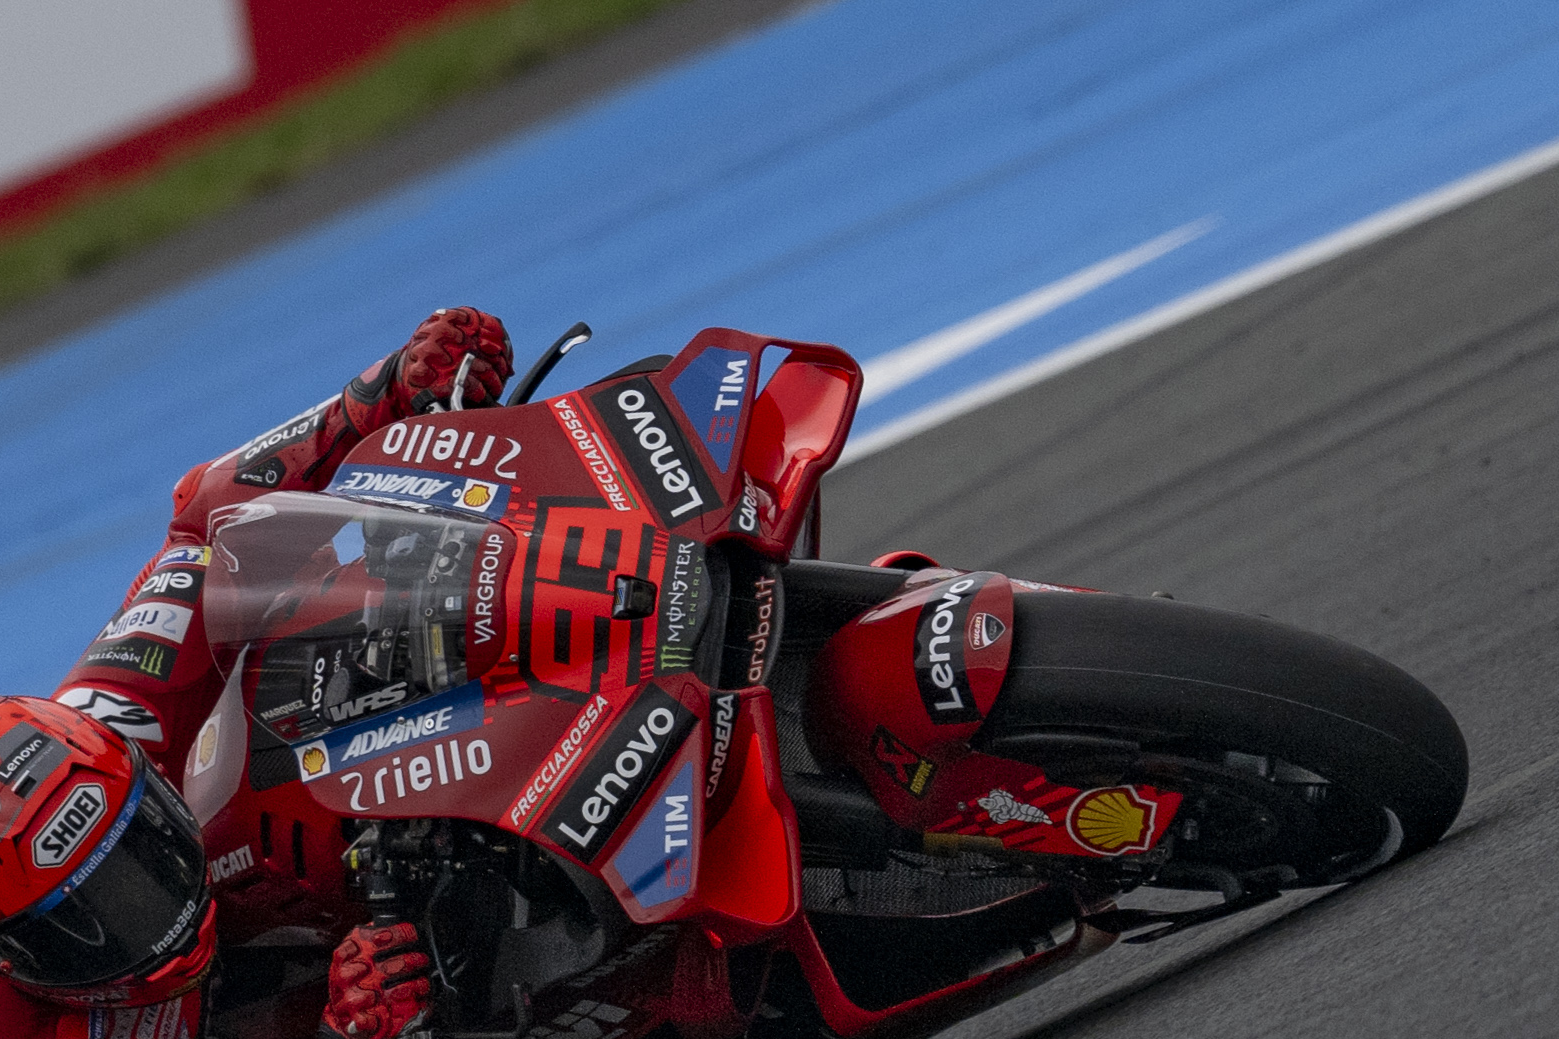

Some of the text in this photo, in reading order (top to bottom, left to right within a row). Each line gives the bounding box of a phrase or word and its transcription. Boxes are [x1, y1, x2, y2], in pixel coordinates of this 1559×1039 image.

[715, 358, 748, 412] TIM
[338, 471, 454, 501] ADVANCE
[552, 398, 632, 512] FRECCIAROSSA
[617, 389, 704, 518] Lenovo
[474, 533, 506, 645] VARGROUP
[668, 541, 696, 643] MONSTER
[747, 575, 777, 684] aruba.it
[929, 578, 976, 711] Lenovo
[260, 699, 307, 720] MARQUEZ
[329, 681, 408, 722] WRS
[341, 706, 453, 762] ADVANCE
[509, 695, 609, 826] FRECCIAROSSA
[558, 707, 675, 847] Lenovo
[705, 694, 735, 798] CARRERA
[42, 789, 101, 860] SHOEI
[665, 794, 689, 853] TIM
[71, 851, 105, 887] Estrella
[210, 845, 255, 883] UCATI
[150, 900, 198, 956] Insta360
